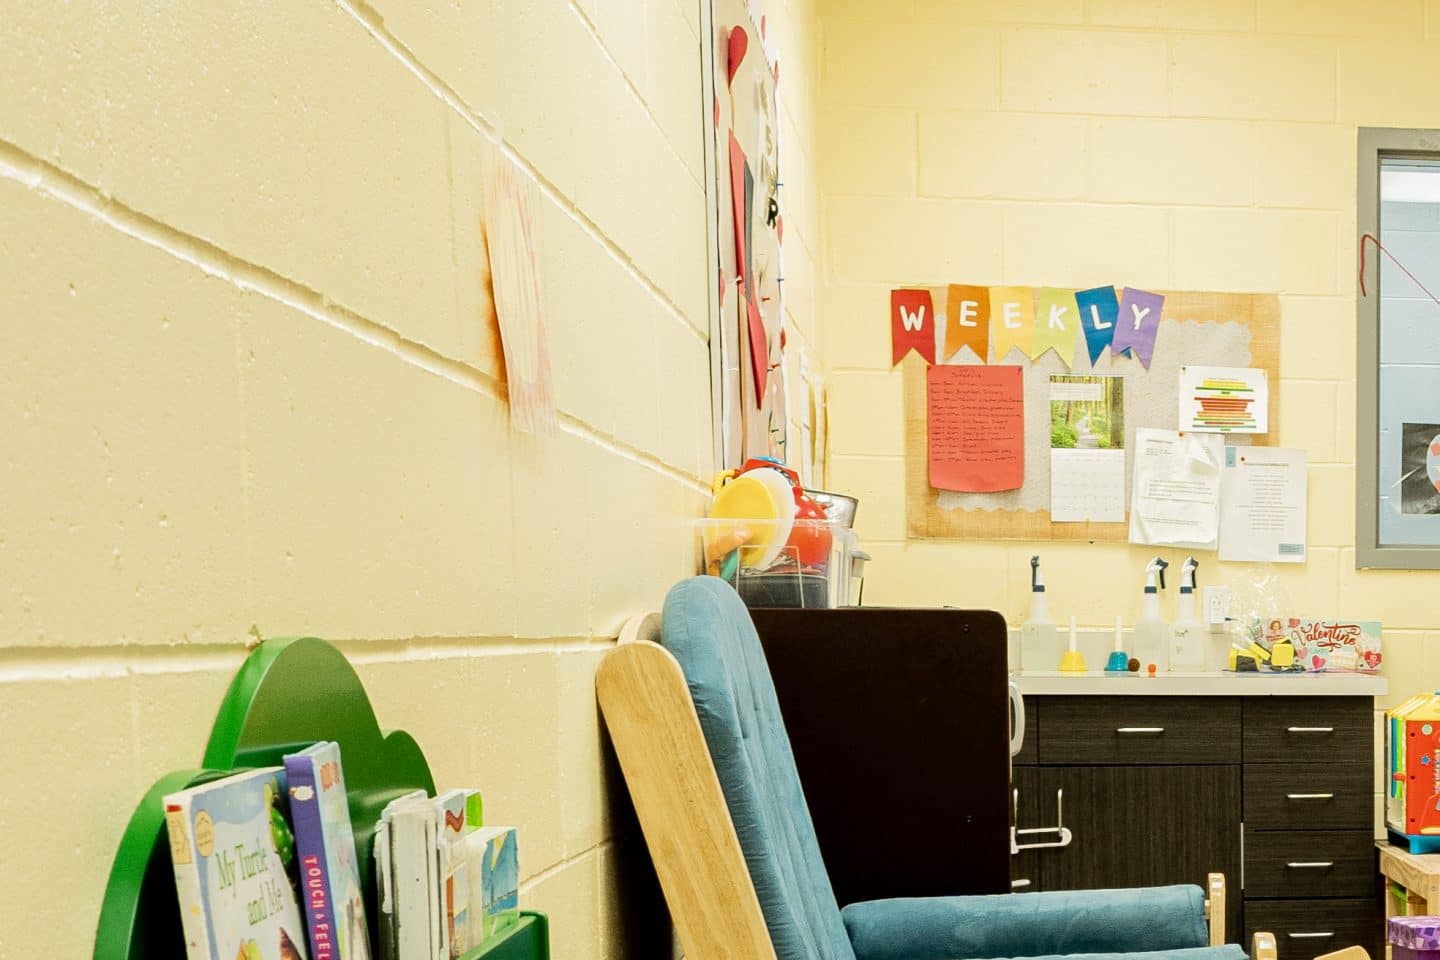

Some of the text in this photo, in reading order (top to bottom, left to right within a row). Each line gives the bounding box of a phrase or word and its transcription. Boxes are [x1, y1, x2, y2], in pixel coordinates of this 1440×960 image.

[900, 300, 1150, 332] WEEKLY
[1291, 622, 1361, 652] Valentine
[215, 848, 236, 899] My
[235, 836, 269, 881] Turtle
[247, 880, 268, 926] and
[304, 856, 325, 909] TOUCH
[315, 923, 332, 960] FEEL
